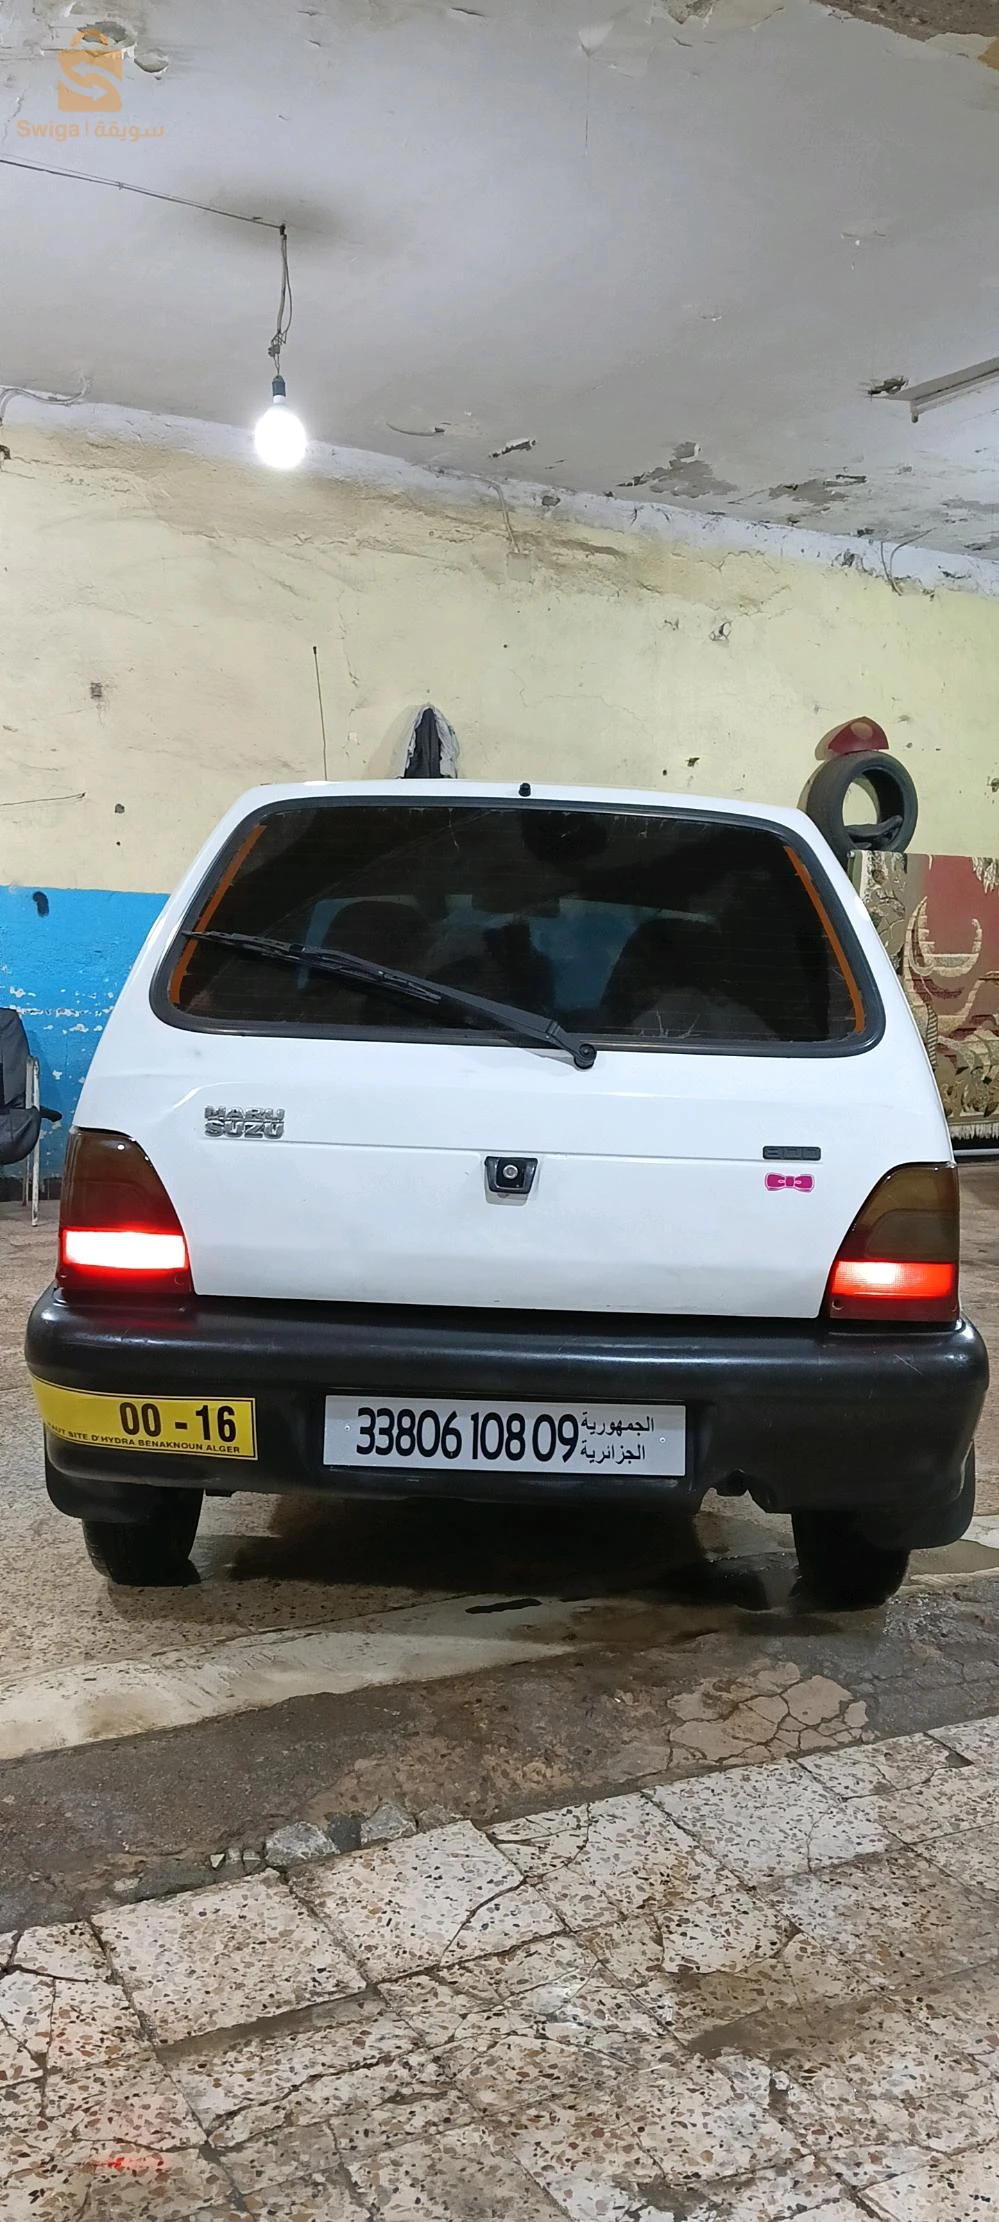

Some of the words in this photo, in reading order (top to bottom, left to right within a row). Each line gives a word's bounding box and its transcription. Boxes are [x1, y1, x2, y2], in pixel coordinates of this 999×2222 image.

[204, 1120, 285, 1140] SUZU
[119, 1401, 162, 1438] 00
[195, 1404, 237, 1443] 16
[355, 1406, 463, 1460] 33806
[470, 1411, 527, 1462] 108
[531, 1413, 580, 1464] 09
[580, 1411, 655, 1437] الجمهورية
[68, 1431, 89, 1441] SITE
[138, 1439, 203, 1451] BENAKNOUN
[205, 1445, 241, 1454] ALGER
